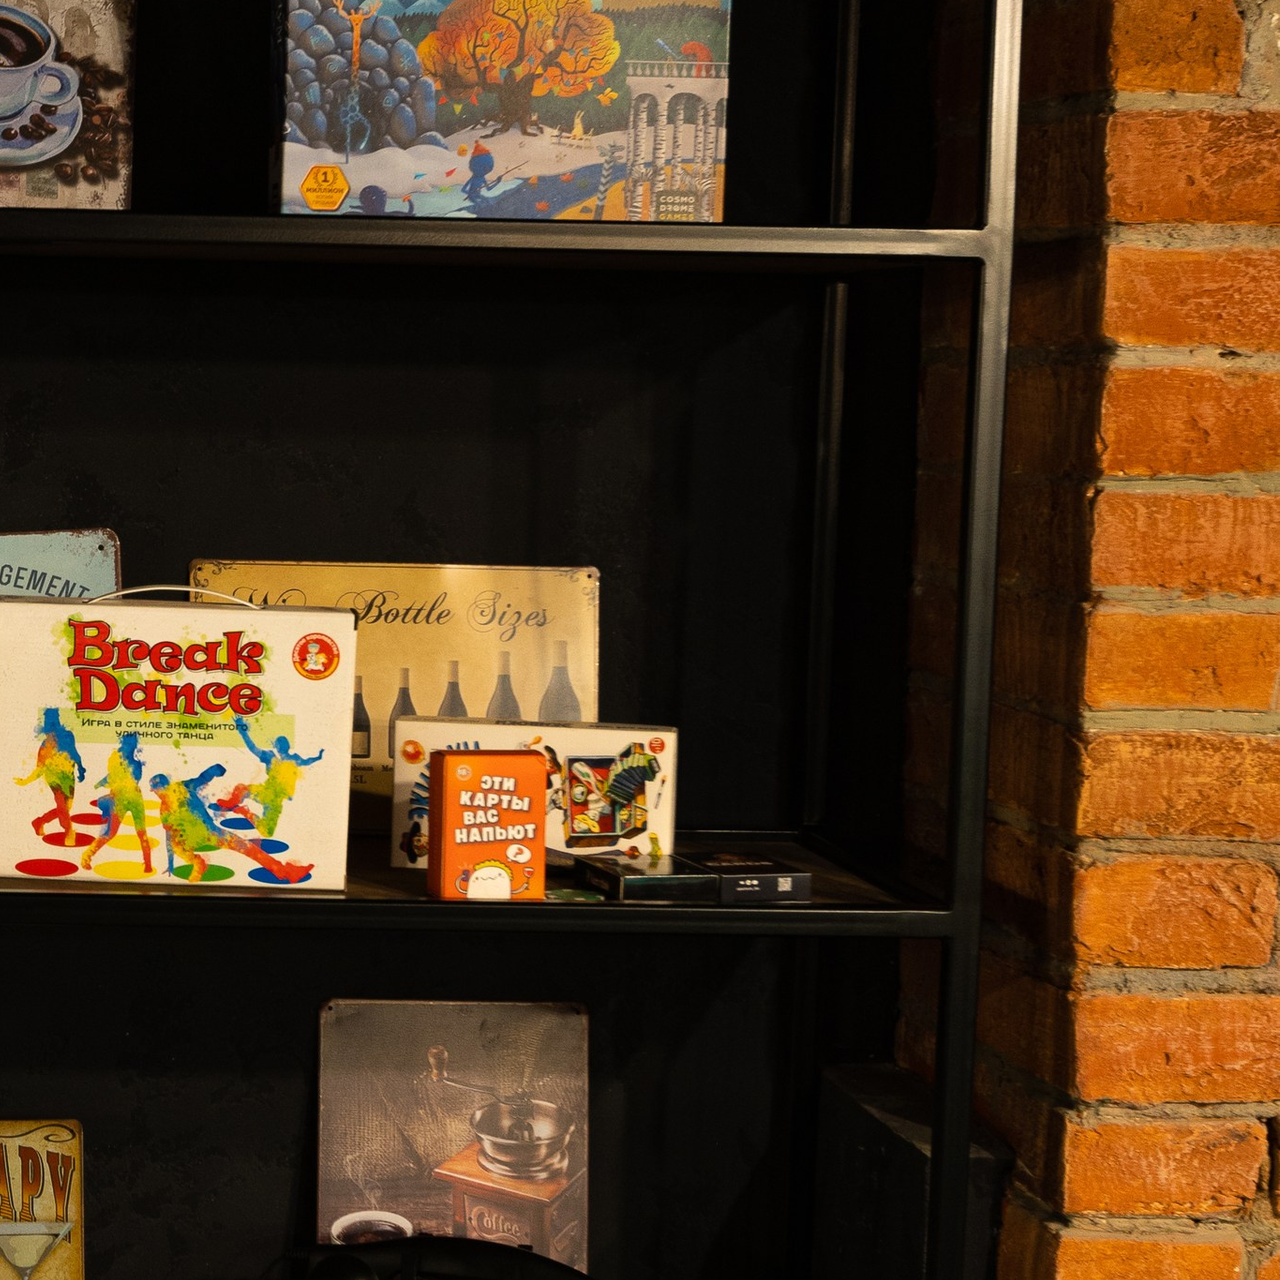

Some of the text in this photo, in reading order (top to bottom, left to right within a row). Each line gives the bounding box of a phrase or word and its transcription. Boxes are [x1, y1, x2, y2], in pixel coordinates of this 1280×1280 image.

[350, 589, 454, 625] Bottle
[467, 590, 552, 643] Sizes
[68, 618, 265, 675] Break
[73, 667, 263, 717] Dance
[480, 775, 516, 792] ЭТИ
[459, 791, 531, 812] КАРТЫ
[462, 808, 499, 825] ВАС
[454, 823, 537, 844] НАПЬЮТ
[471, 1206, 520, 1237] Coffee
